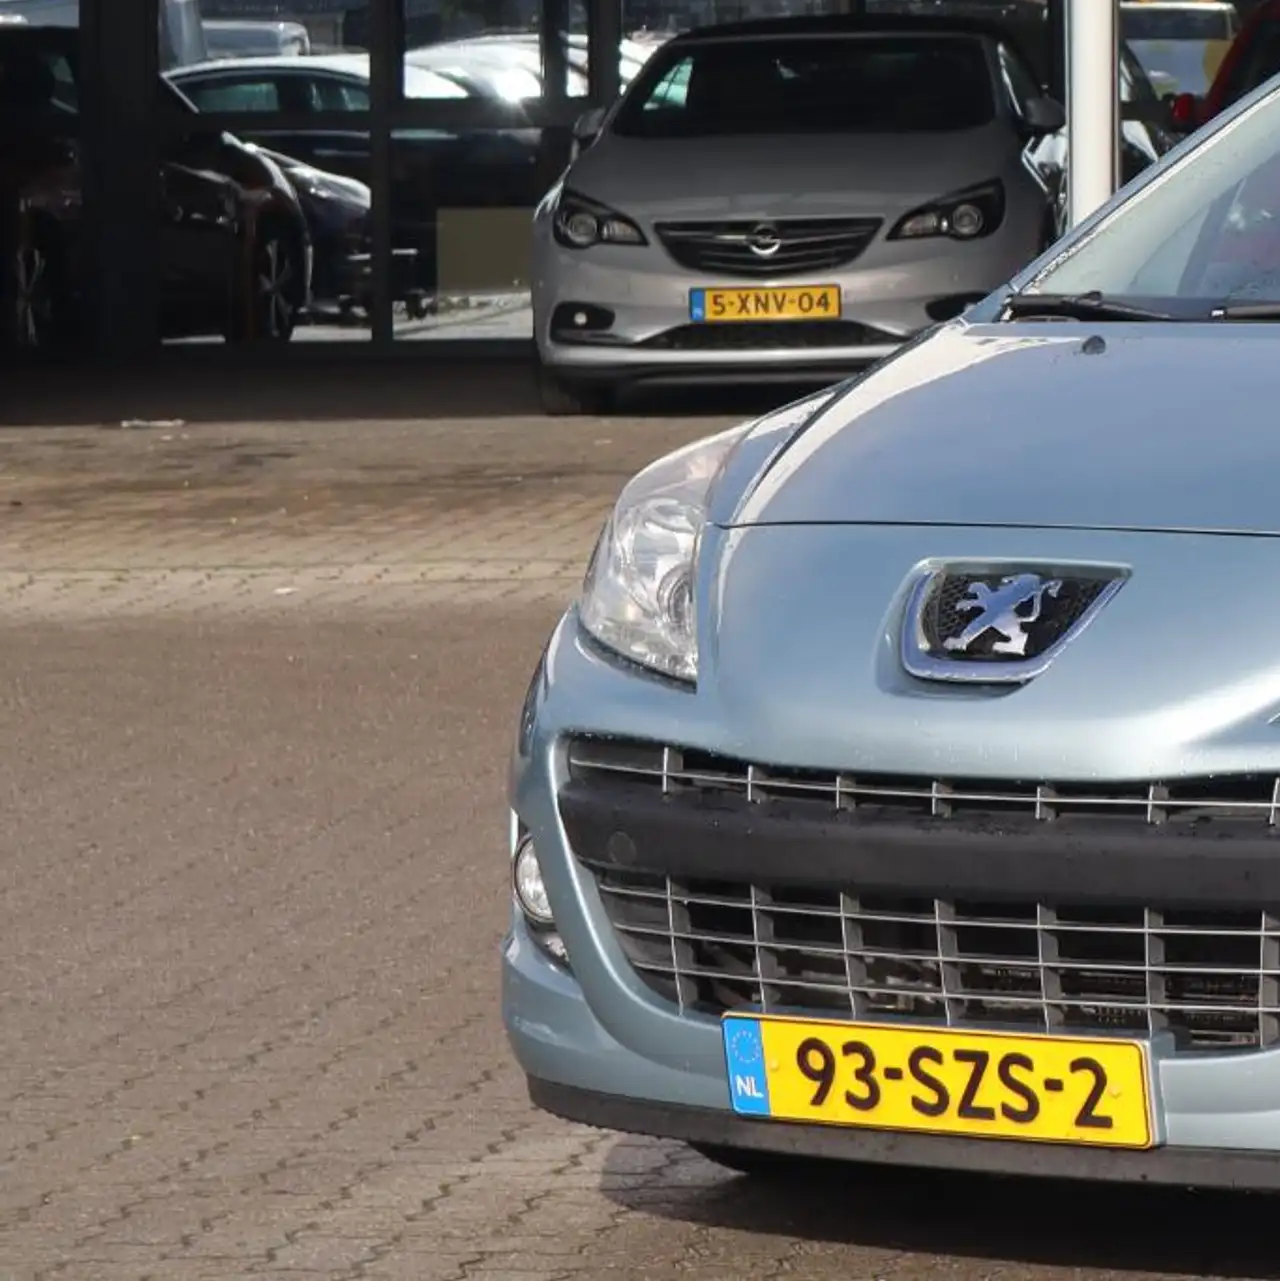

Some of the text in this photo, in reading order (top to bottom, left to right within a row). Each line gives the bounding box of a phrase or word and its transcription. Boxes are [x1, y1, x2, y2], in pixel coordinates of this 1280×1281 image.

[711, 291, 831, 316] 5-XNV-04
[735, 1074, 764, 1099] NL
[795, 1035, 1115, 1129] 93-SZS-2
